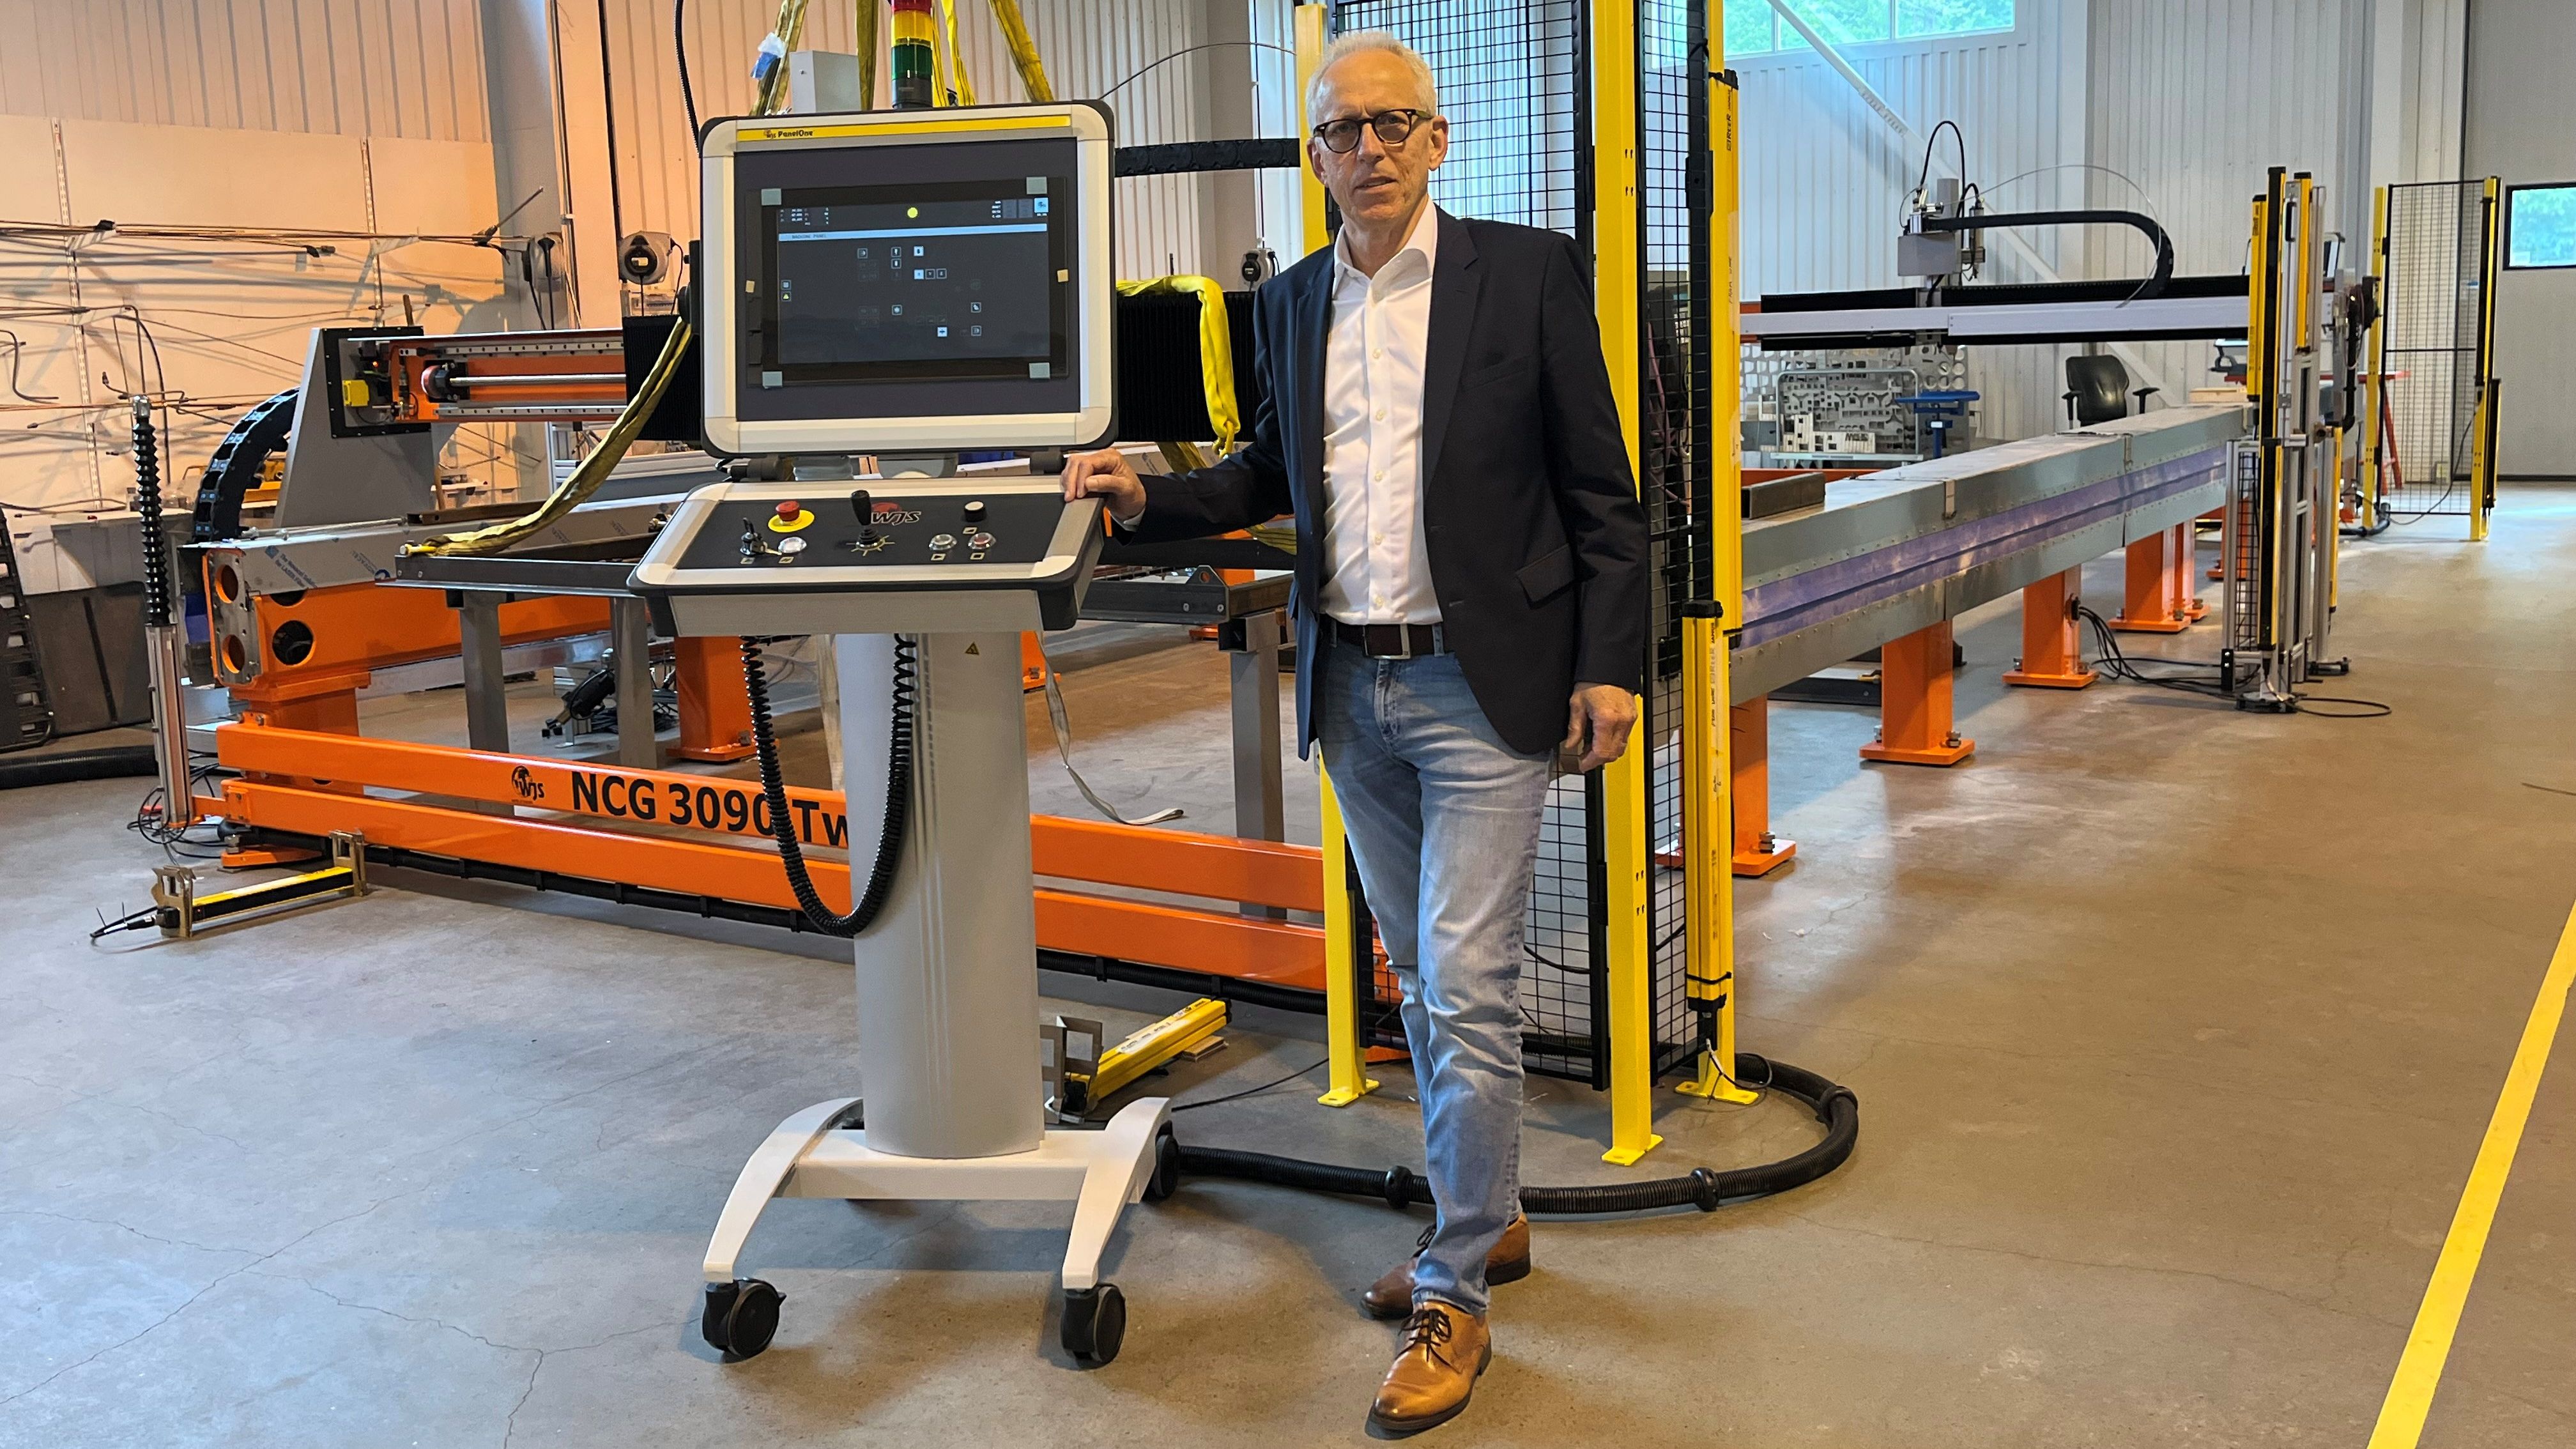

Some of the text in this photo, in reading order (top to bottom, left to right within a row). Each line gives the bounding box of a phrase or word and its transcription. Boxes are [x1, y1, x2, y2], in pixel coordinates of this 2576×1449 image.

[871, 511, 921, 526] WJS
[572, 771, 656, 820] NCG
[669, 783, 774, 836] 3090
